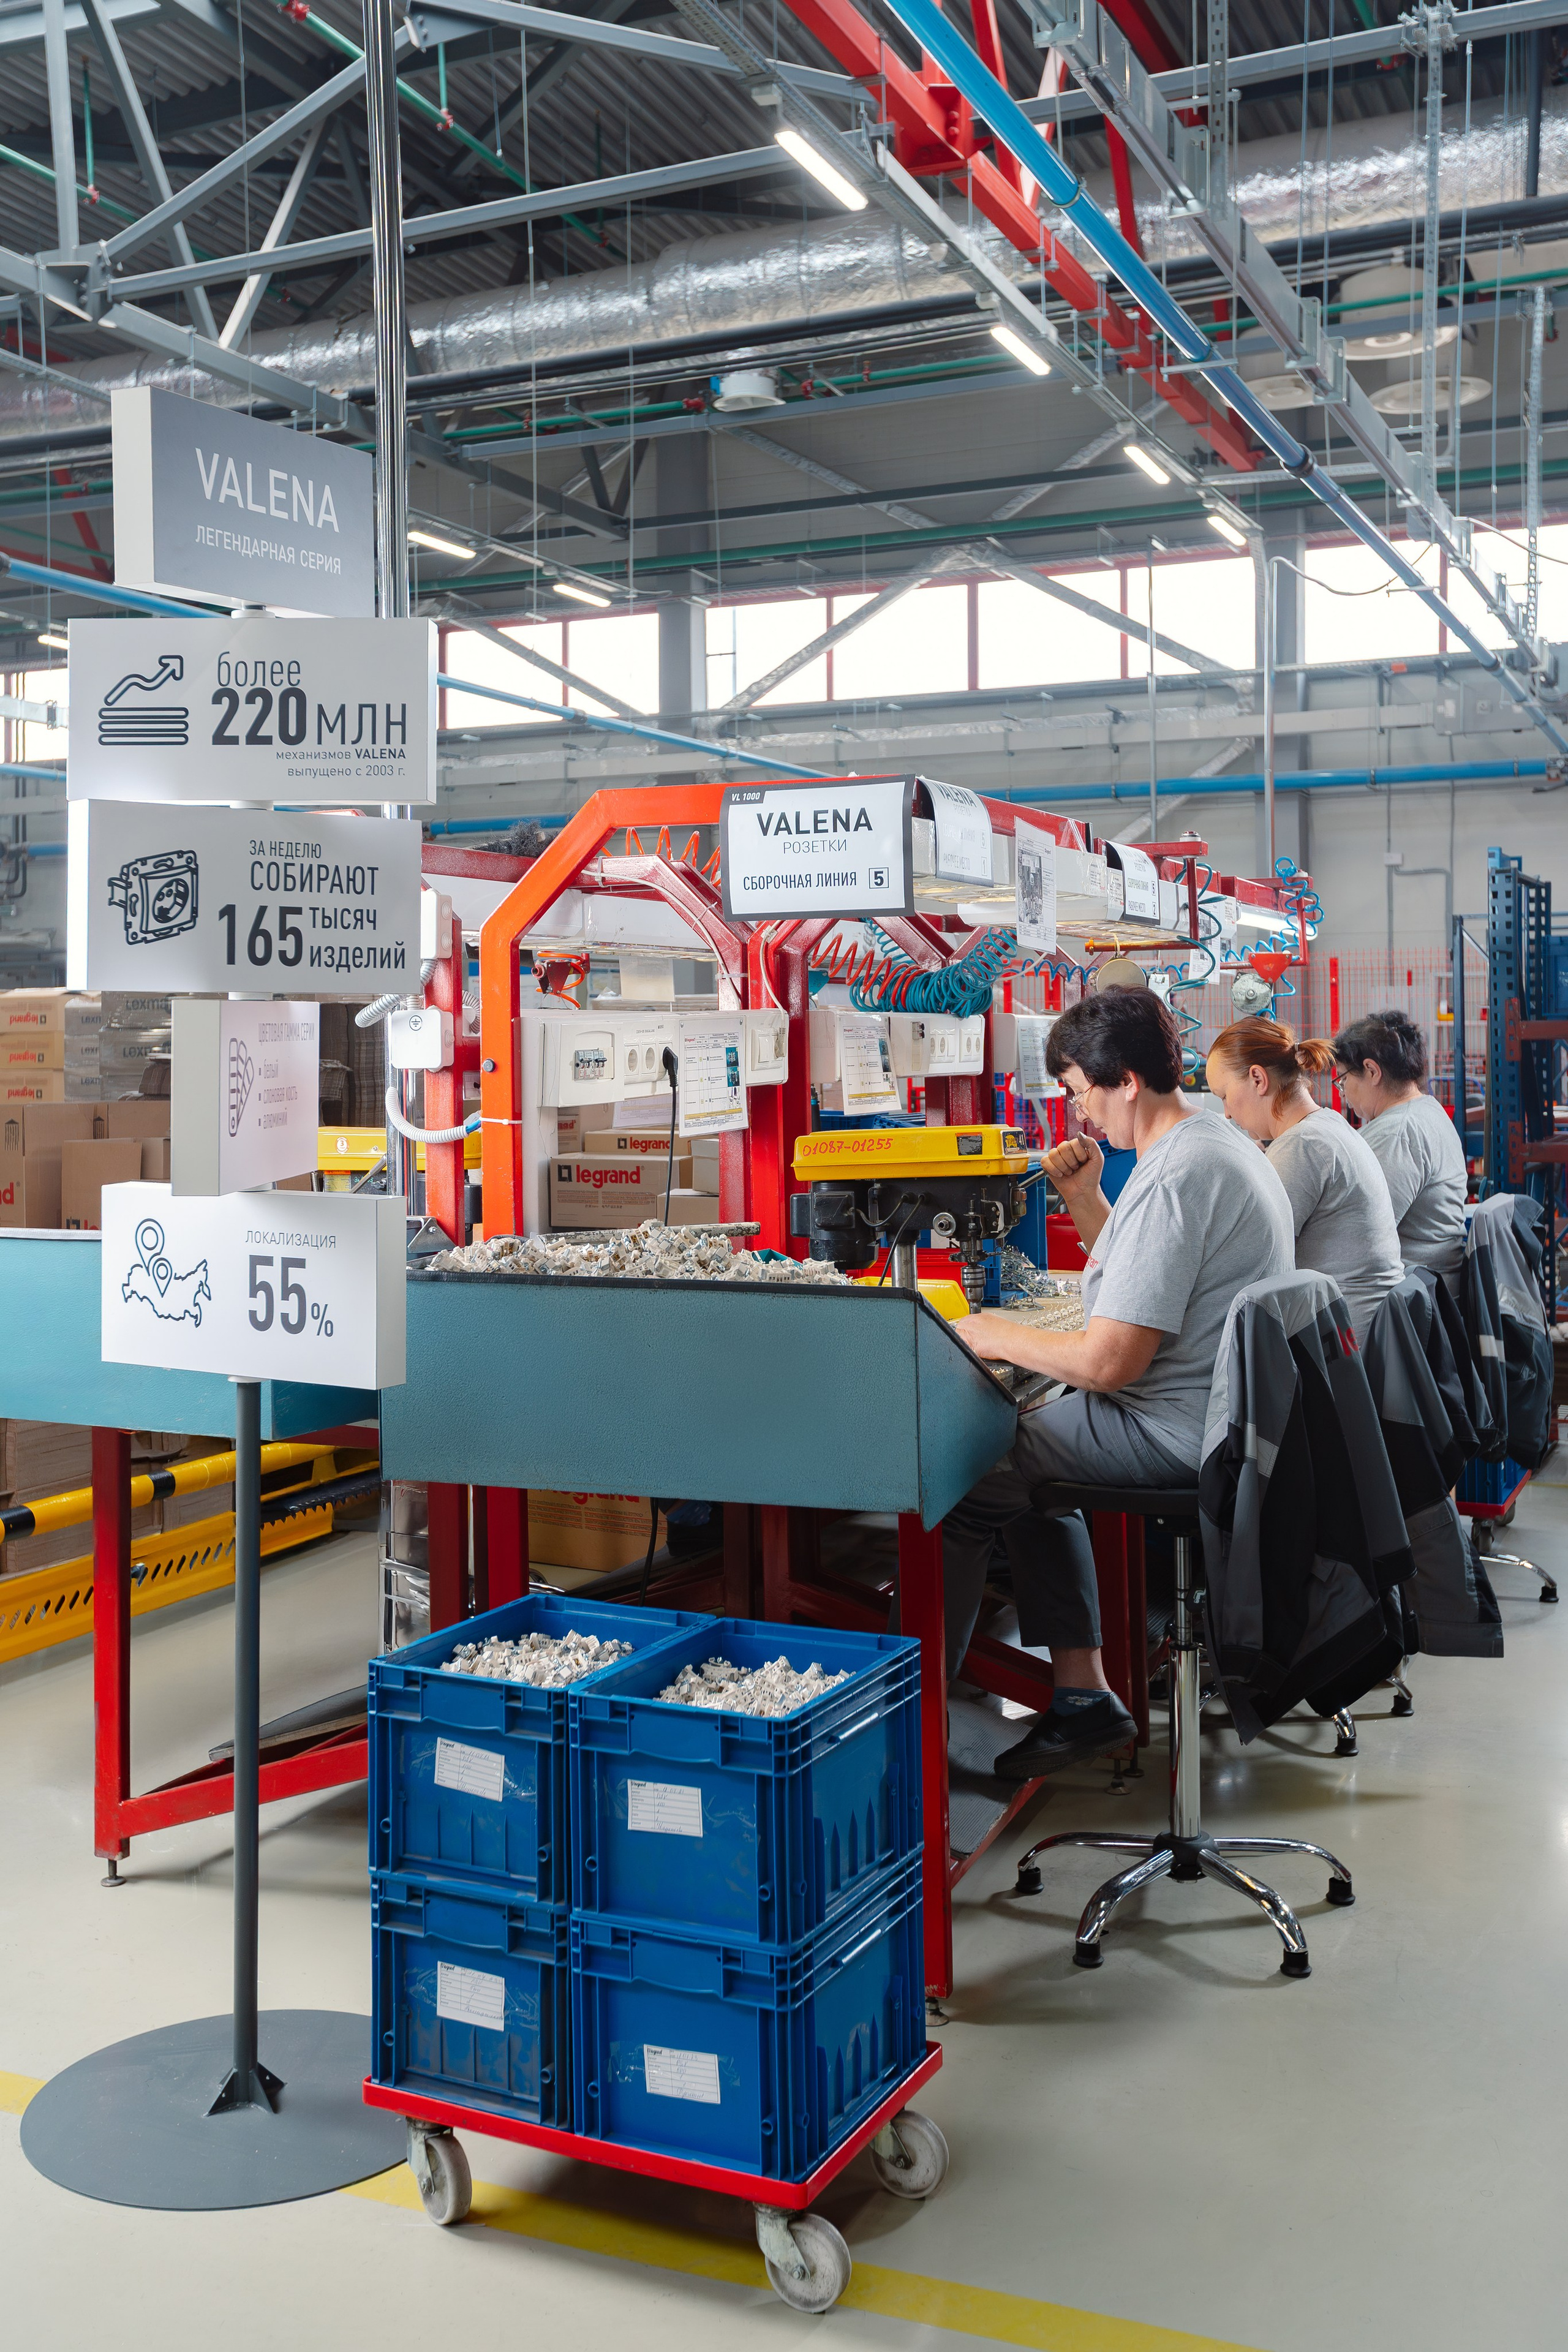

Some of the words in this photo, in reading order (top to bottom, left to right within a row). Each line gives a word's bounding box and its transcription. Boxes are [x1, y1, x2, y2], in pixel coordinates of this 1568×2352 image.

[195, 448, 339, 533] VALENA
[195, 525, 295, 564] ЛЕГЕНДАРНАЯ
[300, 550, 341, 575] СЕРИЯ
[217, 651, 301, 687] более
[211, 687, 306, 745] 220
[317, 703, 406, 745] МЛН
[276, 750, 351, 760] механизмов
[355, 748, 406, 759] VALENA
[288, 767, 351, 778] выпущено
[355, 767, 361, 776] с
[365, 765, 393, 775] 2003
[398, 767, 405, 776] г.
[742, 792, 761, 801] 1000
[932, 782, 977, 808] VALENA
[756, 807, 873, 837] VALENA
[249, 840, 265, 856] ЗА
[270, 841, 322, 859] НЕДЕЛЮ
[783, 839, 847, 854] РОЗЕТКИ
[250, 861, 379, 895] СОБИРАЮТ
[743, 873, 812, 891] СБОРОЧНАЯ
[815, 872, 858, 888] ЛИНИЯ
[873, 870, 884, 887] 5
[309, 907, 376, 930] тысяч
[218, 904, 303, 967] 165
[309, 941, 405, 973] изделий
[258, 1023, 283, 1046] ЦВЕТОВАЯ
[284, 1023, 300, 1042] ГАММА
[301, 1023, 315, 1041] СЕРИИ
[263, 1088, 285, 1104] слоновая
[285, 1086, 298, 1102] кость
[263, 1107, 288, 1129] алюминий
[802, 1138, 894, 1156] 01087-01255
[576, 1164, 641, 1189] legrand
[245, 1231, 336, 1250] ЛОКАЛИЗАЦИЯ
